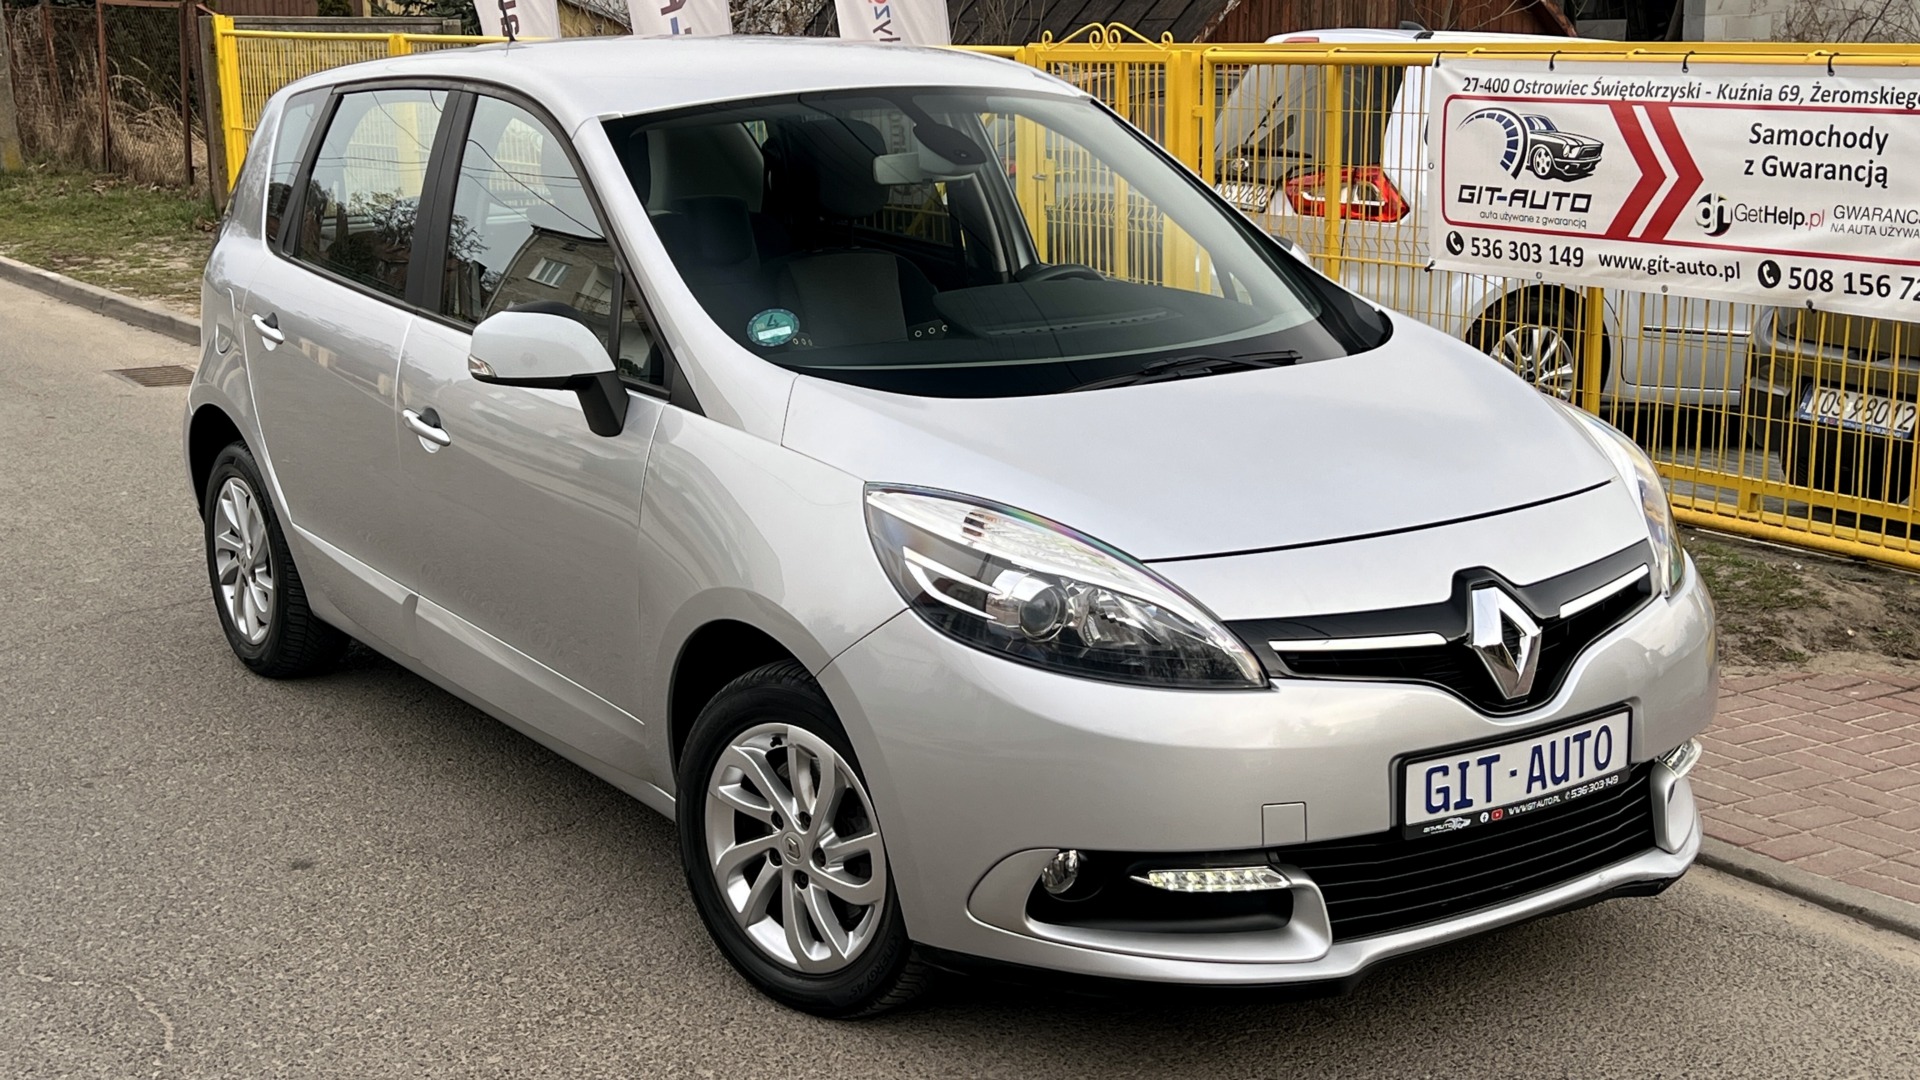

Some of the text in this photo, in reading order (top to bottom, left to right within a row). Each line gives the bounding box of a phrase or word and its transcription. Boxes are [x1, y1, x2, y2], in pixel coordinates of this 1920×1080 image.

[1462, 77, 1510, 94] 27-400
[1513, 79, 1589, 96] Ostrowiec
[1591, 77, 1702, 102] Świętokrzyski
[1716, 83, 1773, 101] Kuźnia
[1778, 85, 1804, 105] 69,
[1748, 122, 1889, 155] Samochody
[1743, 155, 1889, 189] z Gwarancją
[1457, 184, 1593, 213] GIT-AUTO
[1479, 210, 1498, 220] auta
[1499, 212, 1535, 224] używane
[1541, 217, 1587, 229] gwarancją
[1734, 203, 1825, 232] GetHelp.pl
[1833, 204, 1920, 225] GWARANC
[1830, 223, 1846, 234] NA
[1847, 224, 1877, 236] AUTA
[1470, 236, 1584, 268] 536 303 149
[1598, 253, 1741, 282] www.git-auto.pl
[1787, 266, 1834, 293] 508
[1843, 272, 1892, 298] 156
